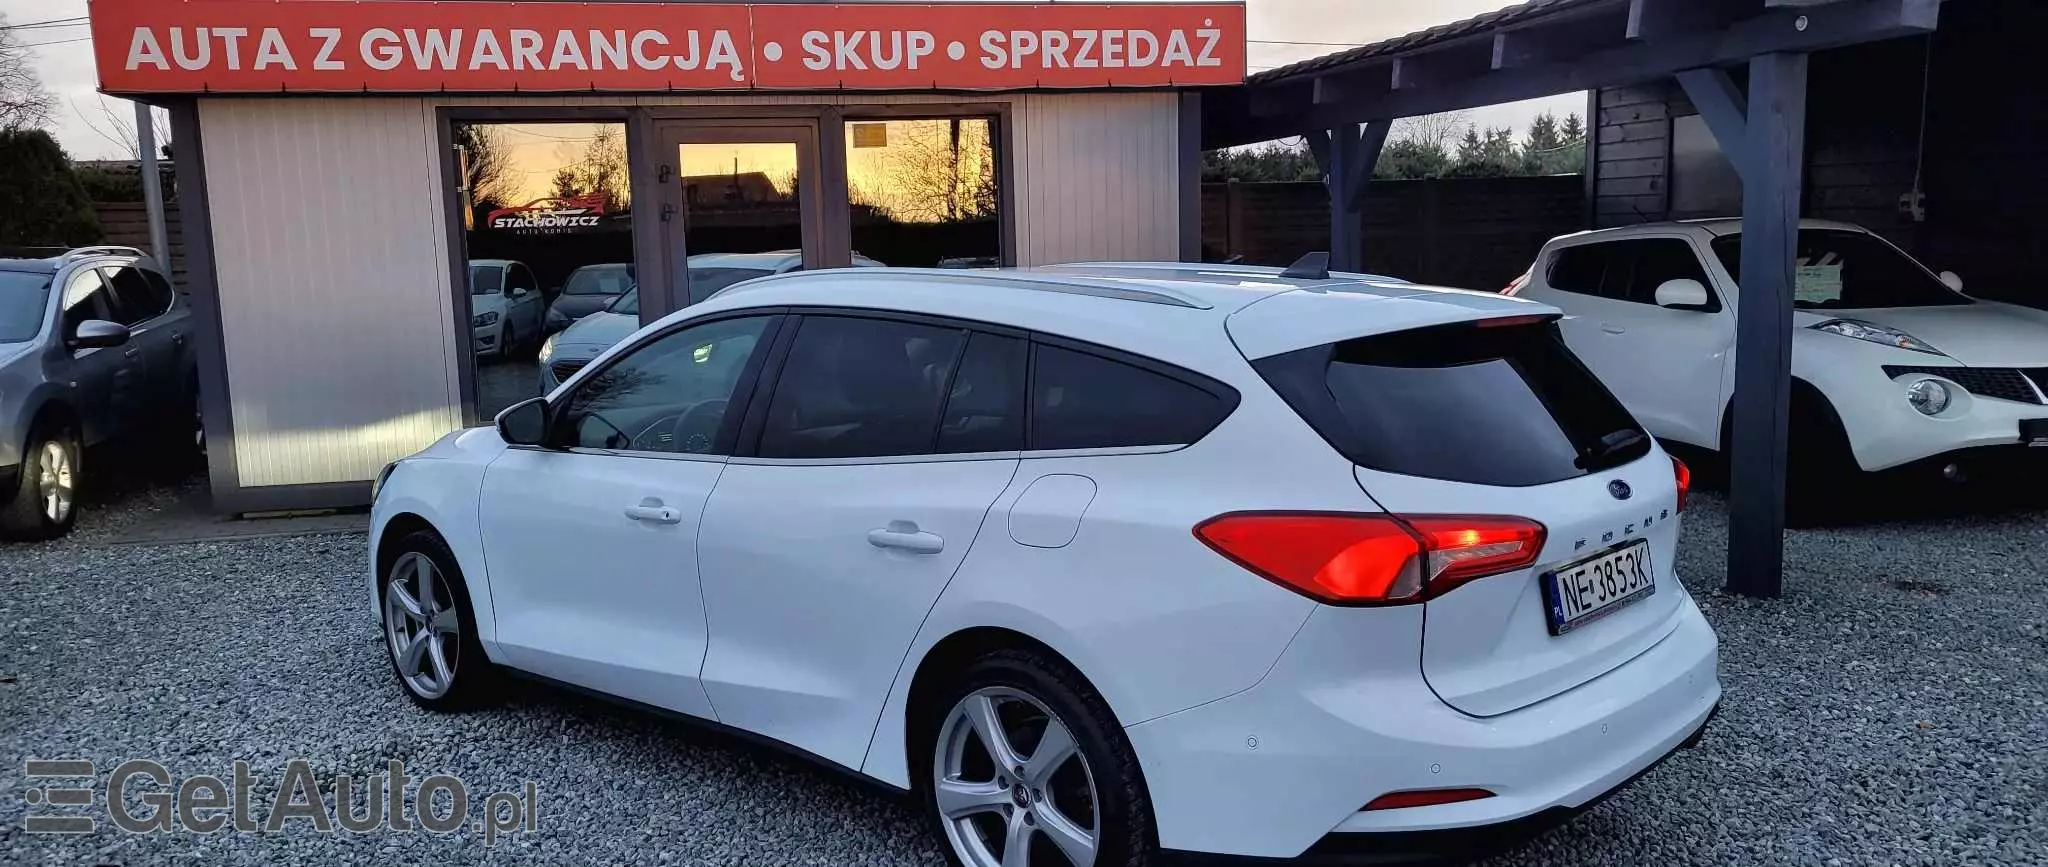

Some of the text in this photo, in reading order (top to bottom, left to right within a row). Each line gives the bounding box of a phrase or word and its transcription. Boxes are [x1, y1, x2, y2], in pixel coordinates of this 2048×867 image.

[125, 19, 1221, 80] AUTA Z GWARANCJĄ SKUP SPRZEDAŻ
[494, 216, 600, 228] STACHOWICZ
[1593, 547, 1649, 601] 3853K
